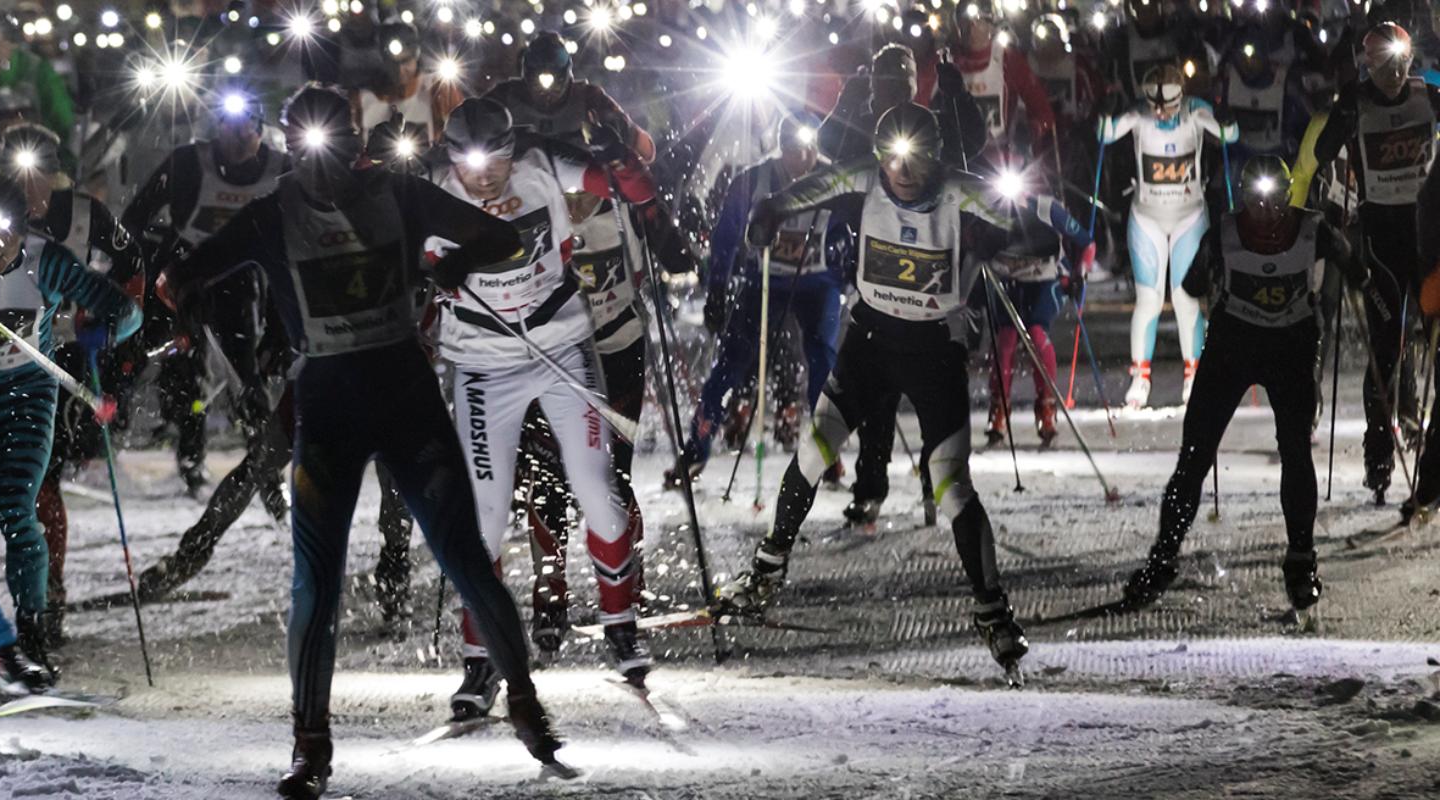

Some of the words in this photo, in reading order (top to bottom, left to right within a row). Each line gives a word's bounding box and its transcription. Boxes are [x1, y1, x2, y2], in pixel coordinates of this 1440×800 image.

[479, 273, 532, 287] helvetia
[898, 258, 916, 282] 2
[345, 270, 368, 299] 4
[873, 289, 923, 307] helvetia
[1252, 287, 1287, 305] 45
[466, 387, 494, 482] MADSHUS
